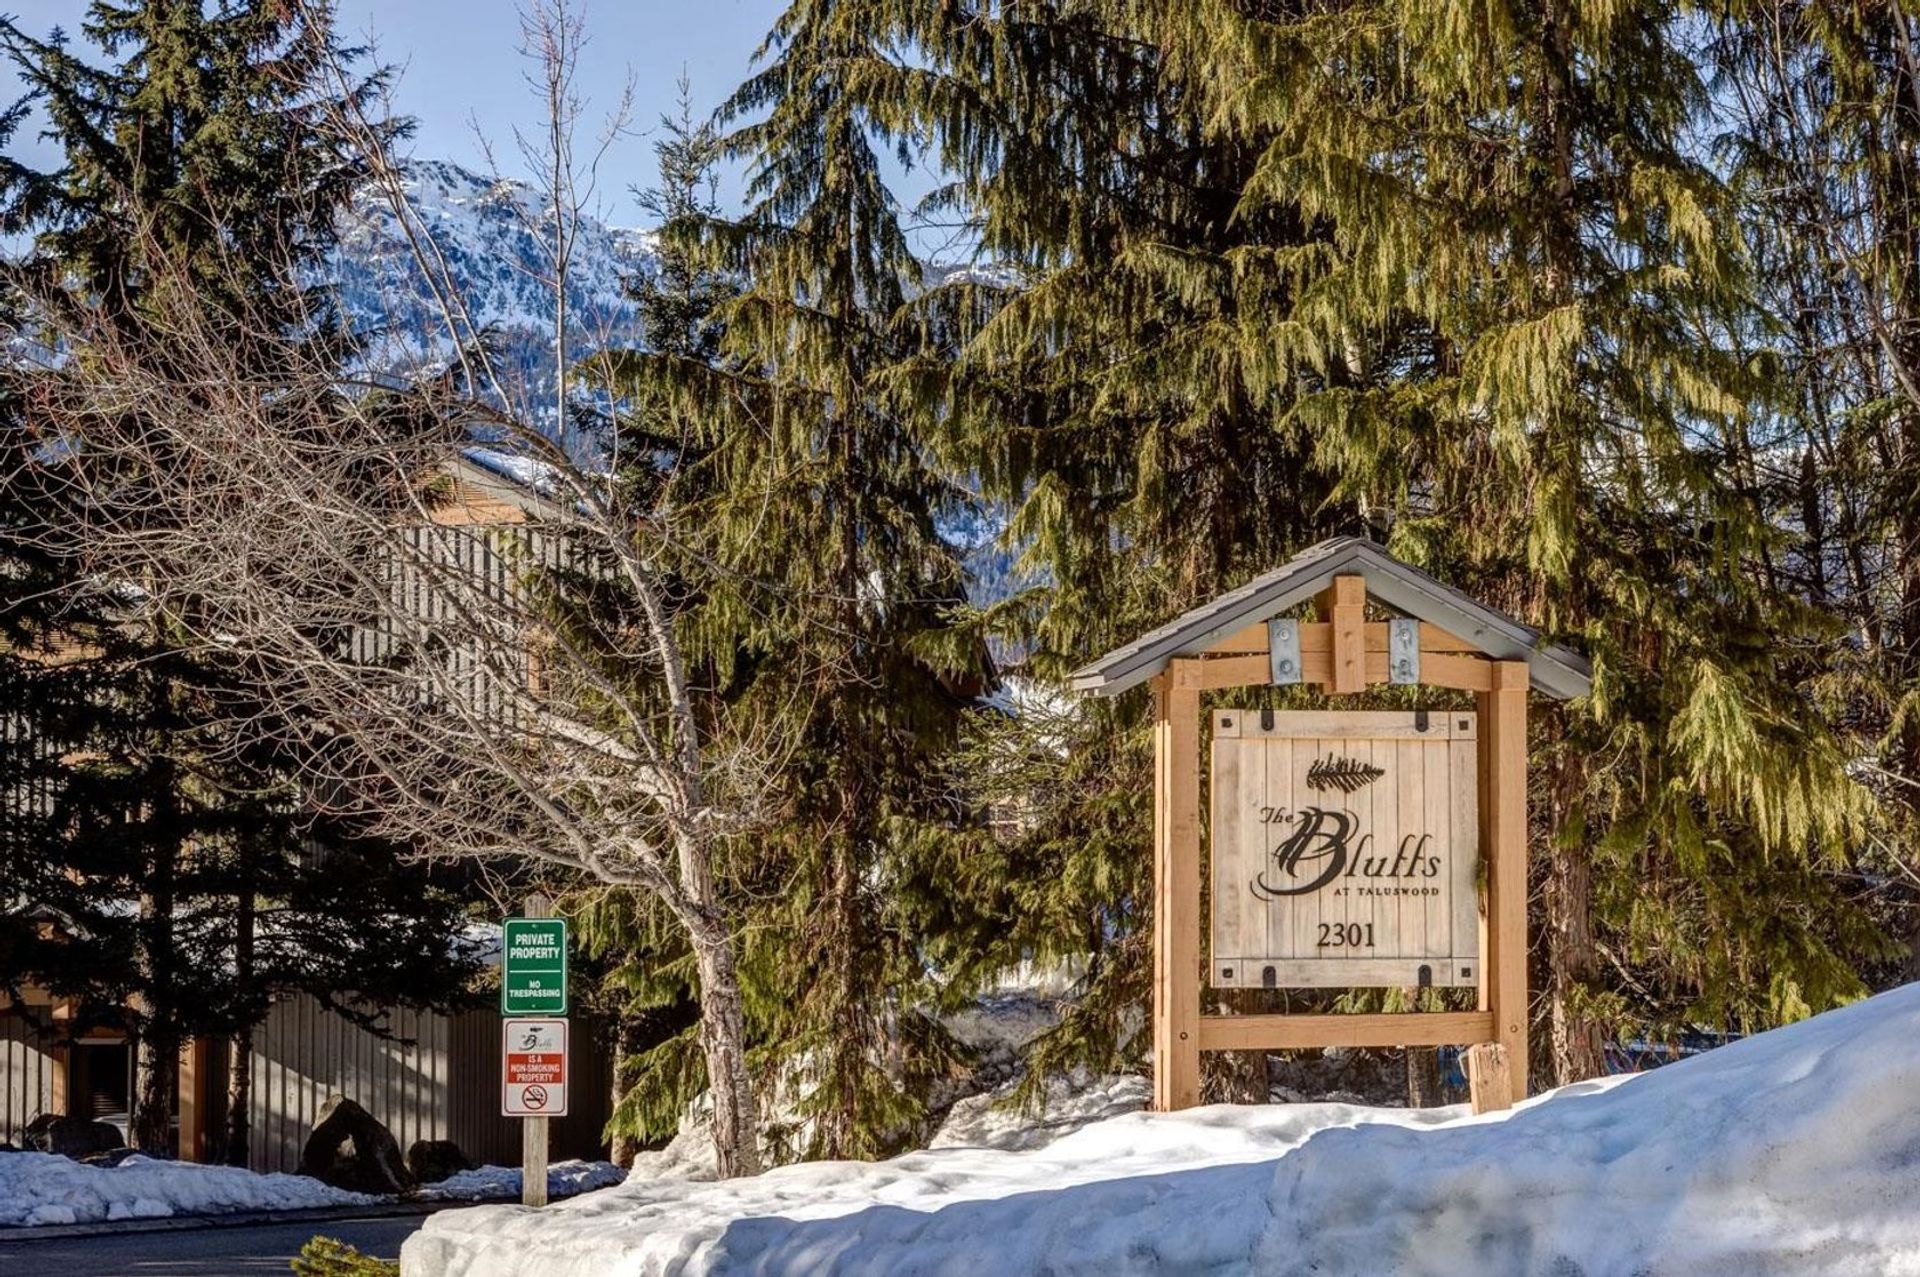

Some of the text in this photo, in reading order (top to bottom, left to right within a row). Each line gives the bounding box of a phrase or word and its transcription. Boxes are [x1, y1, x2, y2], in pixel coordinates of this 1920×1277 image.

[1259, 806, 1295, 824] The
[1250, 806, 1441, 902] Bluffs
[1334, 887, 1440, 897] AT TALUSWOOD
[515, 933, 555, 945] PRIVATE
[1317, 922, 1375, 947] 2301
[510, 947, 560, 959] PROPERTY
[529, 980, 541, 988] NO
[509, 989, 560, 997] TRESPASSING
[528, 1055, 542, 1063] IS A
[510, 1064, 560, 1073] NON-SMOKING
[516, 1073, 554, 1082] PROPERTY
